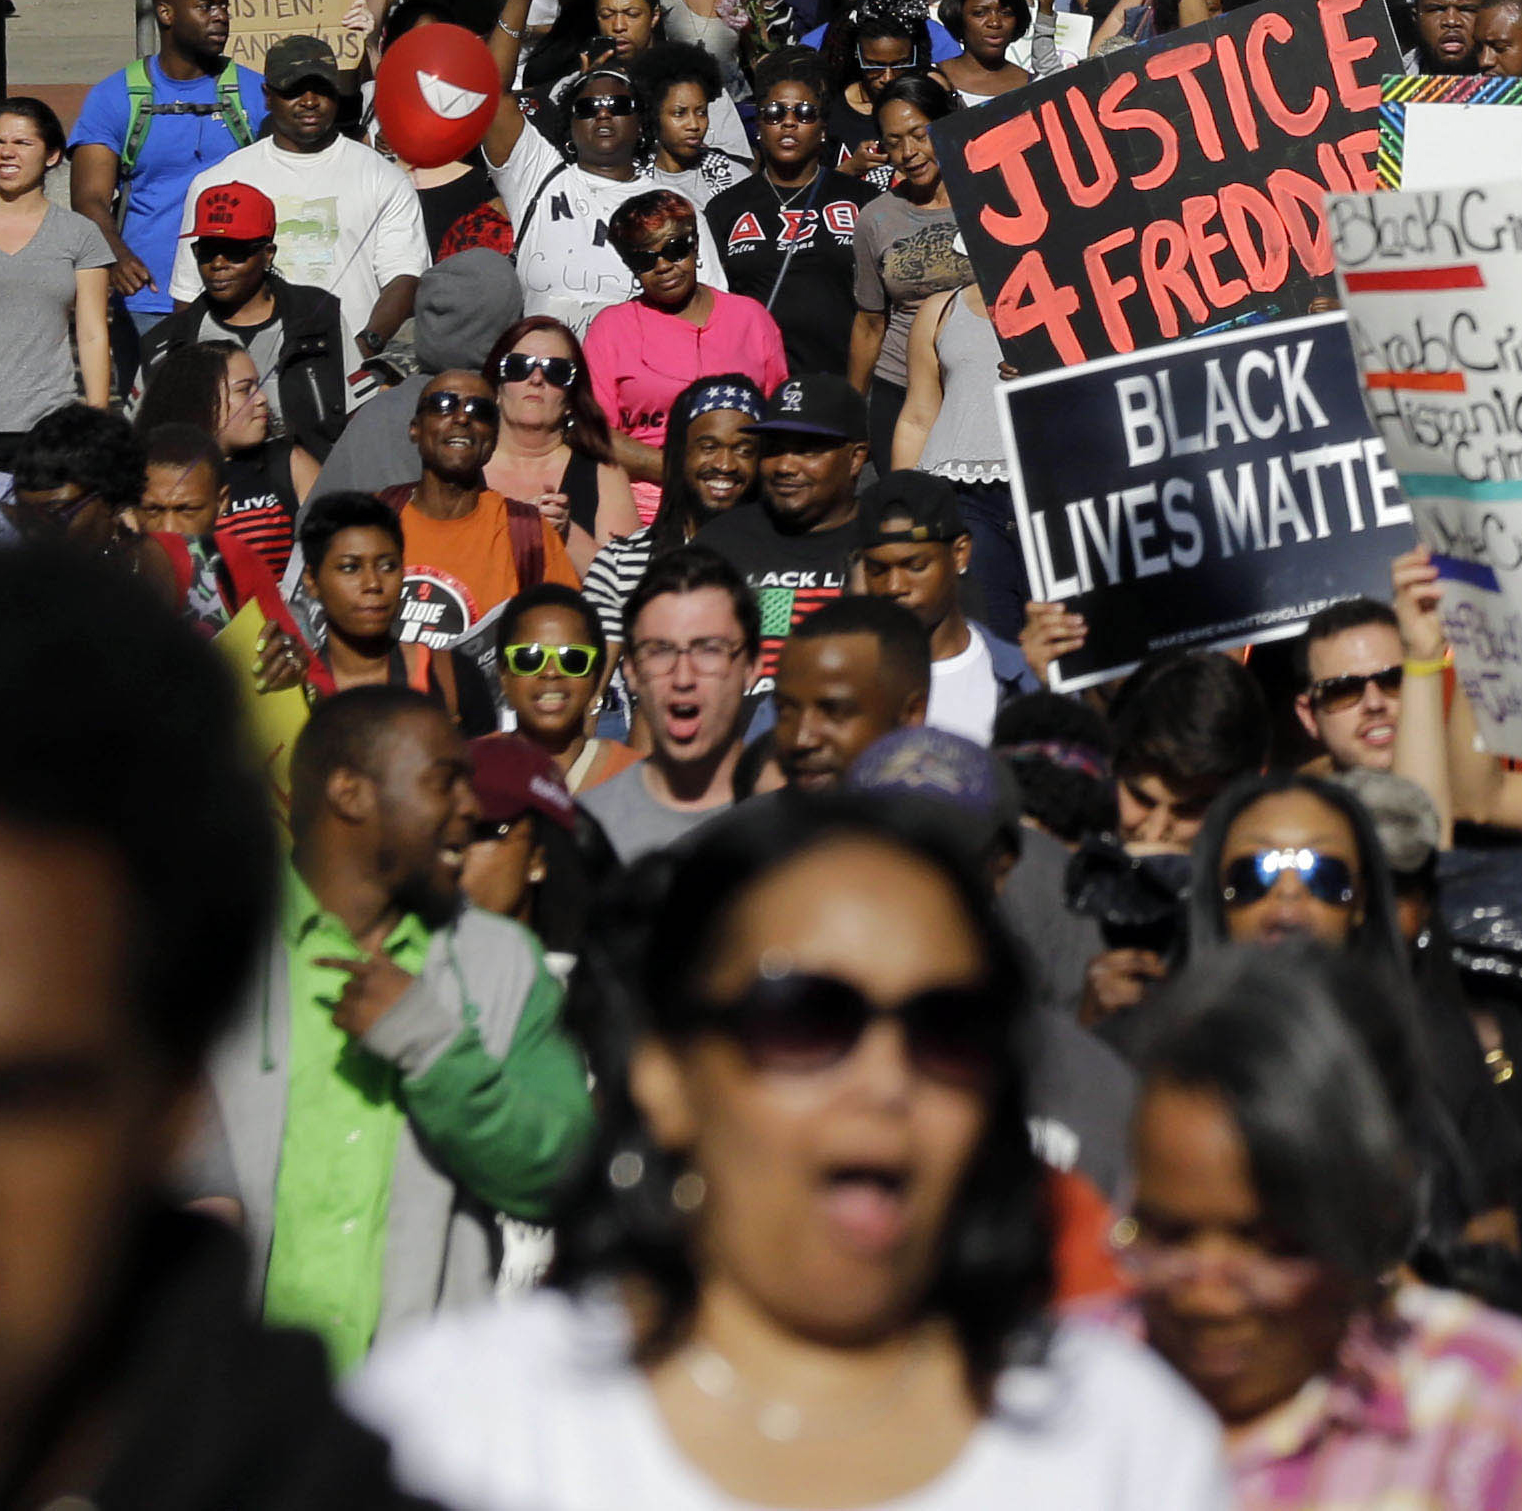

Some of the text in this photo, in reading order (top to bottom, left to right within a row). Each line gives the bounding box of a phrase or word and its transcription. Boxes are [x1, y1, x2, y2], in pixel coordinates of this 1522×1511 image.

[993, 250, 1088, 367] 4
[1114, 339, 1329, 469] BLACK
[1030, 437, 1412, 603] LIVES MATTE
